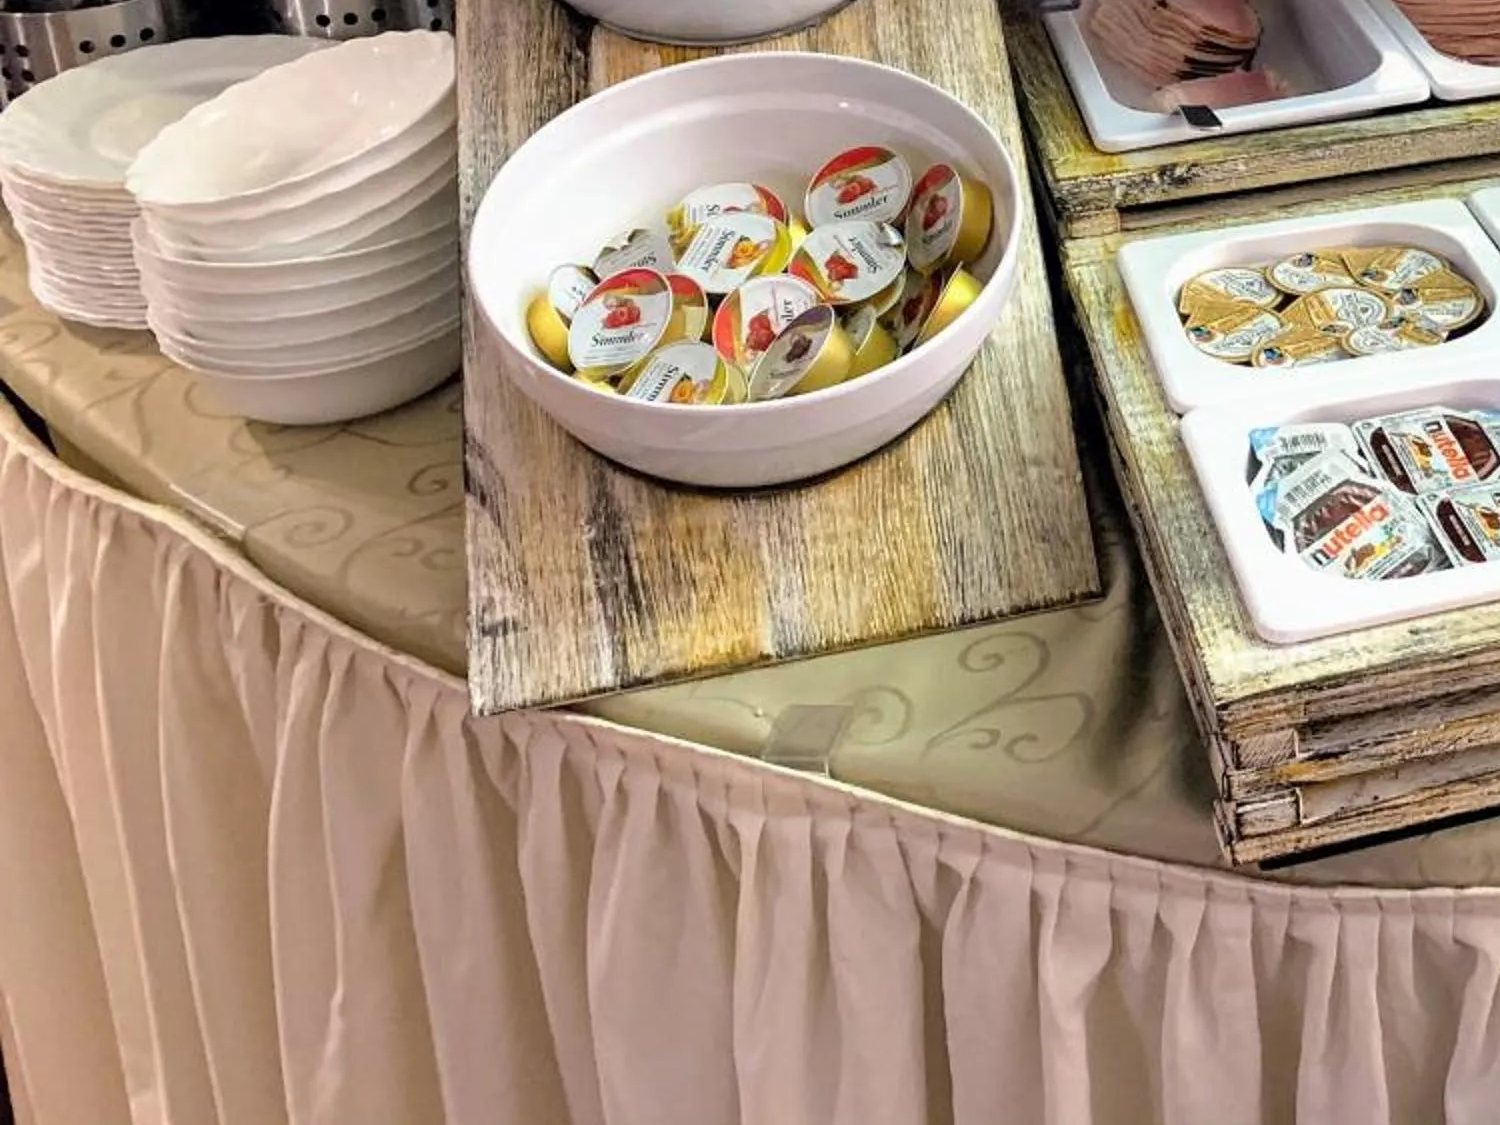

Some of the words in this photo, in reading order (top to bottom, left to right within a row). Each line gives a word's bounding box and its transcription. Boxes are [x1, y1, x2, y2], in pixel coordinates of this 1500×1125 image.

[832, 193, 890, 221] Simmler
[701, 229, 737, 272] Simmler
[590, 330, 646, 349] Simmler
[1423, 420, 1470, 480] nutella
[1309, 502, 1390, 567] nutella
